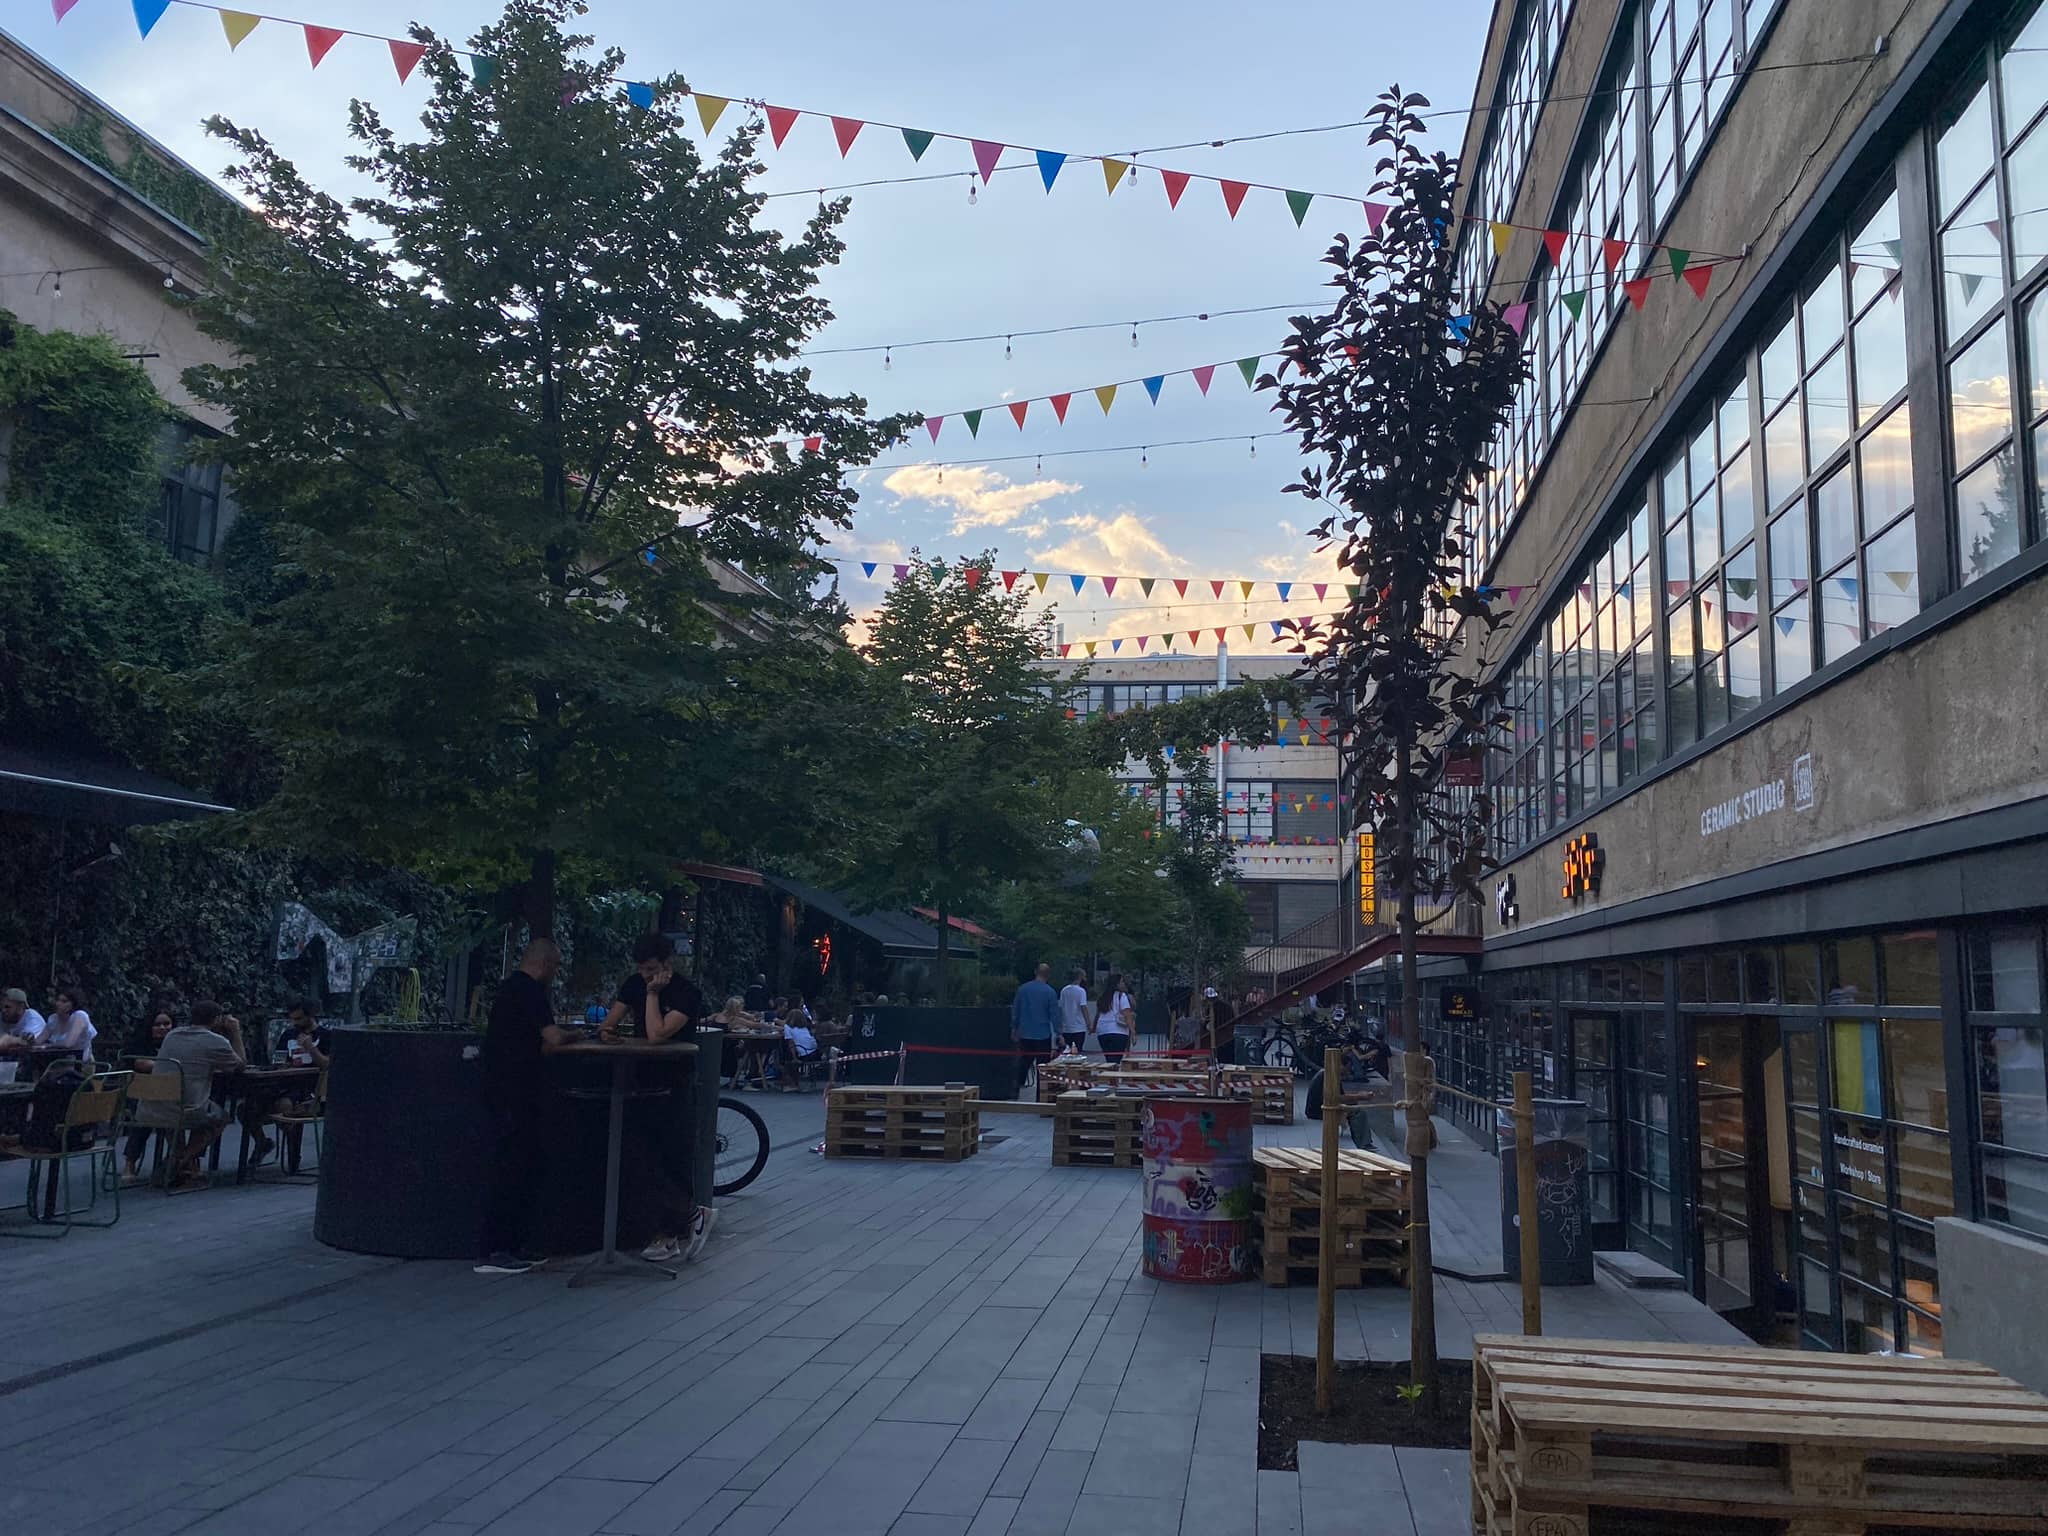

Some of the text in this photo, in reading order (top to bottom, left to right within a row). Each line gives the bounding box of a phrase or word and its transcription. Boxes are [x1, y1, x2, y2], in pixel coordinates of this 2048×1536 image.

[1701, 779, 1785, 836] CERAMIC STUDIO
[1833, 1132, 1885, 1155] Handcrafted ceramics
[1840, 1162, 1864, 1181] Workshop
[1867, 1170, 1882, 1185] Store
